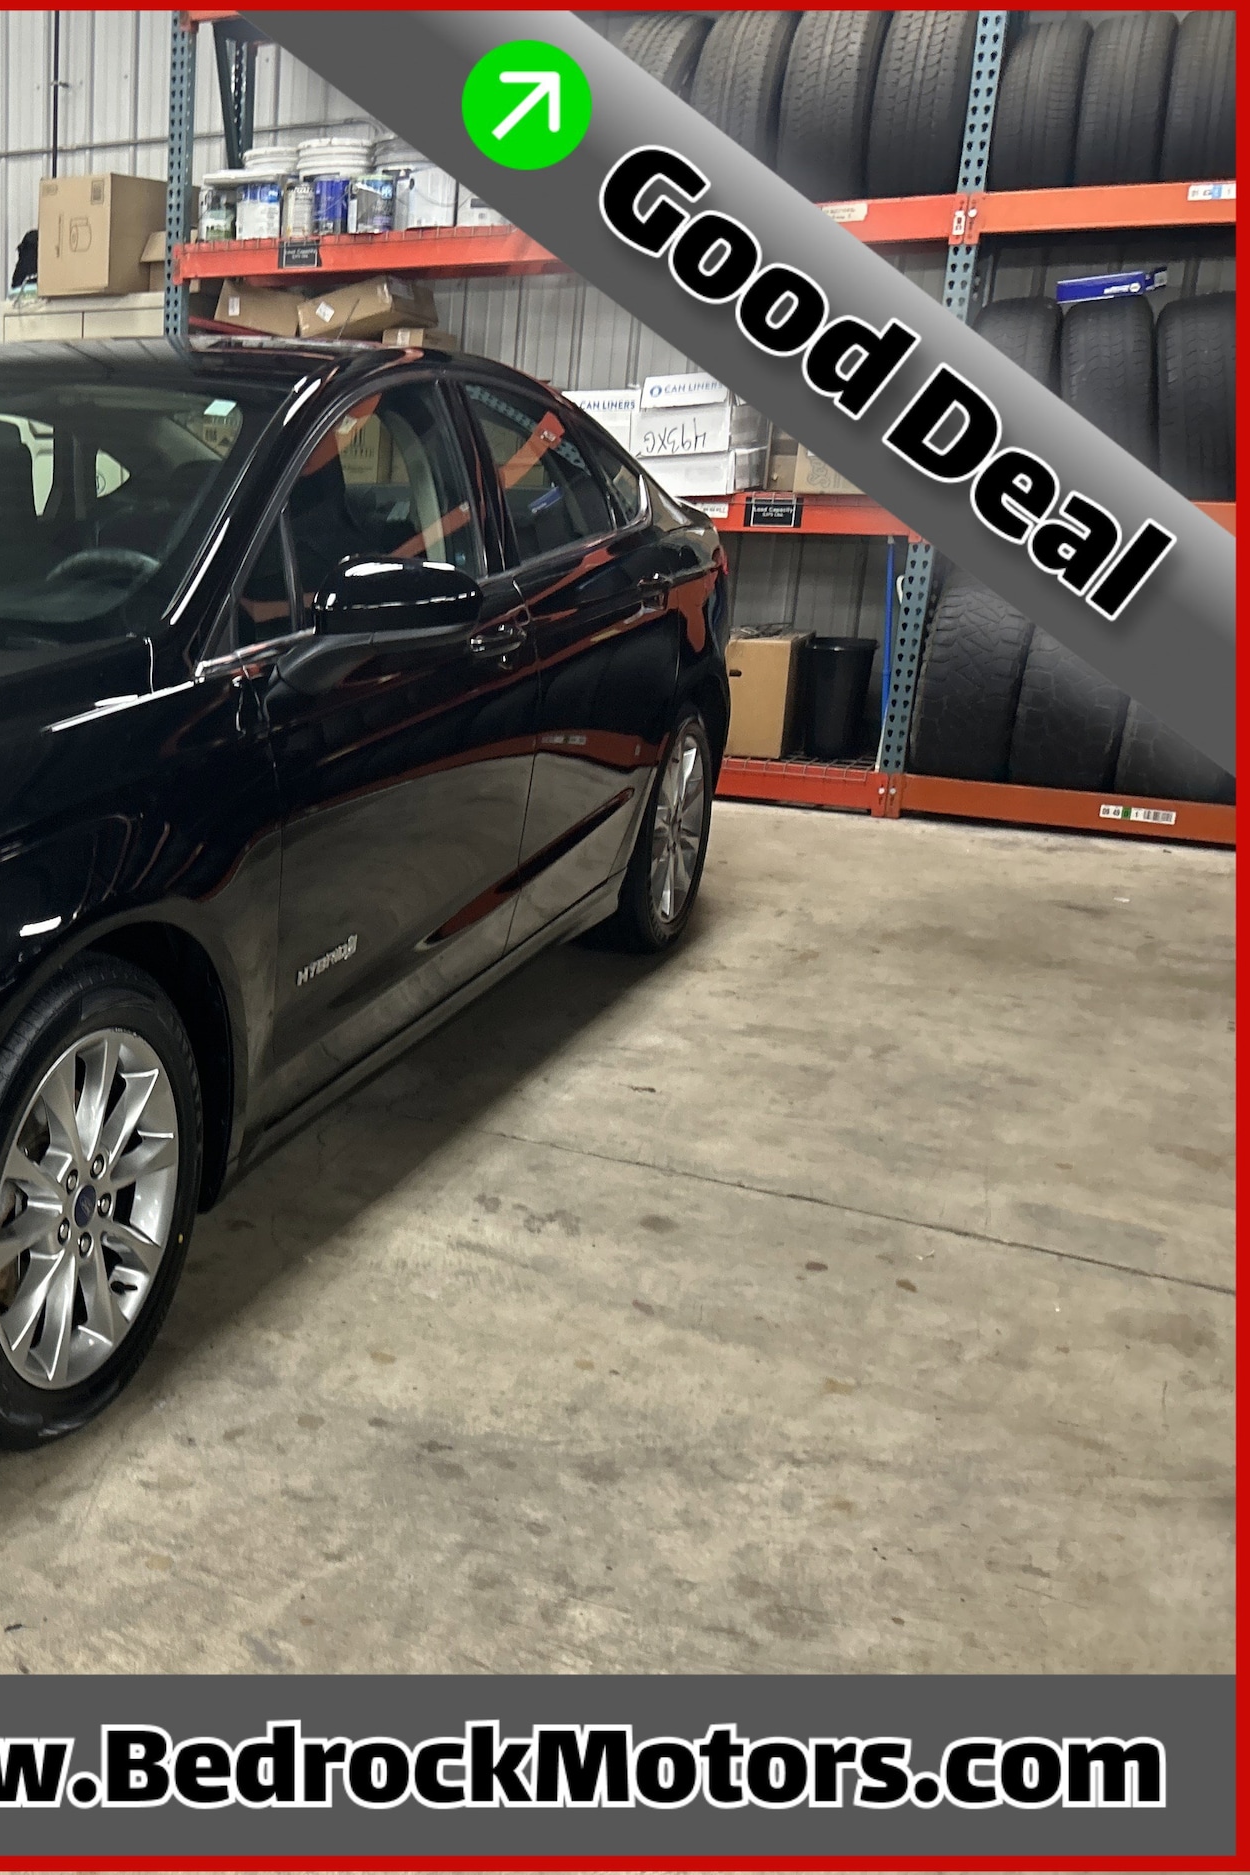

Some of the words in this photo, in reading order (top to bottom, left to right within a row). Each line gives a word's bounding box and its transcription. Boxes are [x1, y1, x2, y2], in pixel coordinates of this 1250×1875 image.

[663, 383, 686, 394] CAN
[688, 381, 723, 392] LINERS
[580, 401, 600, 411] CAN
[602, 400, 635, 410] LINERS
